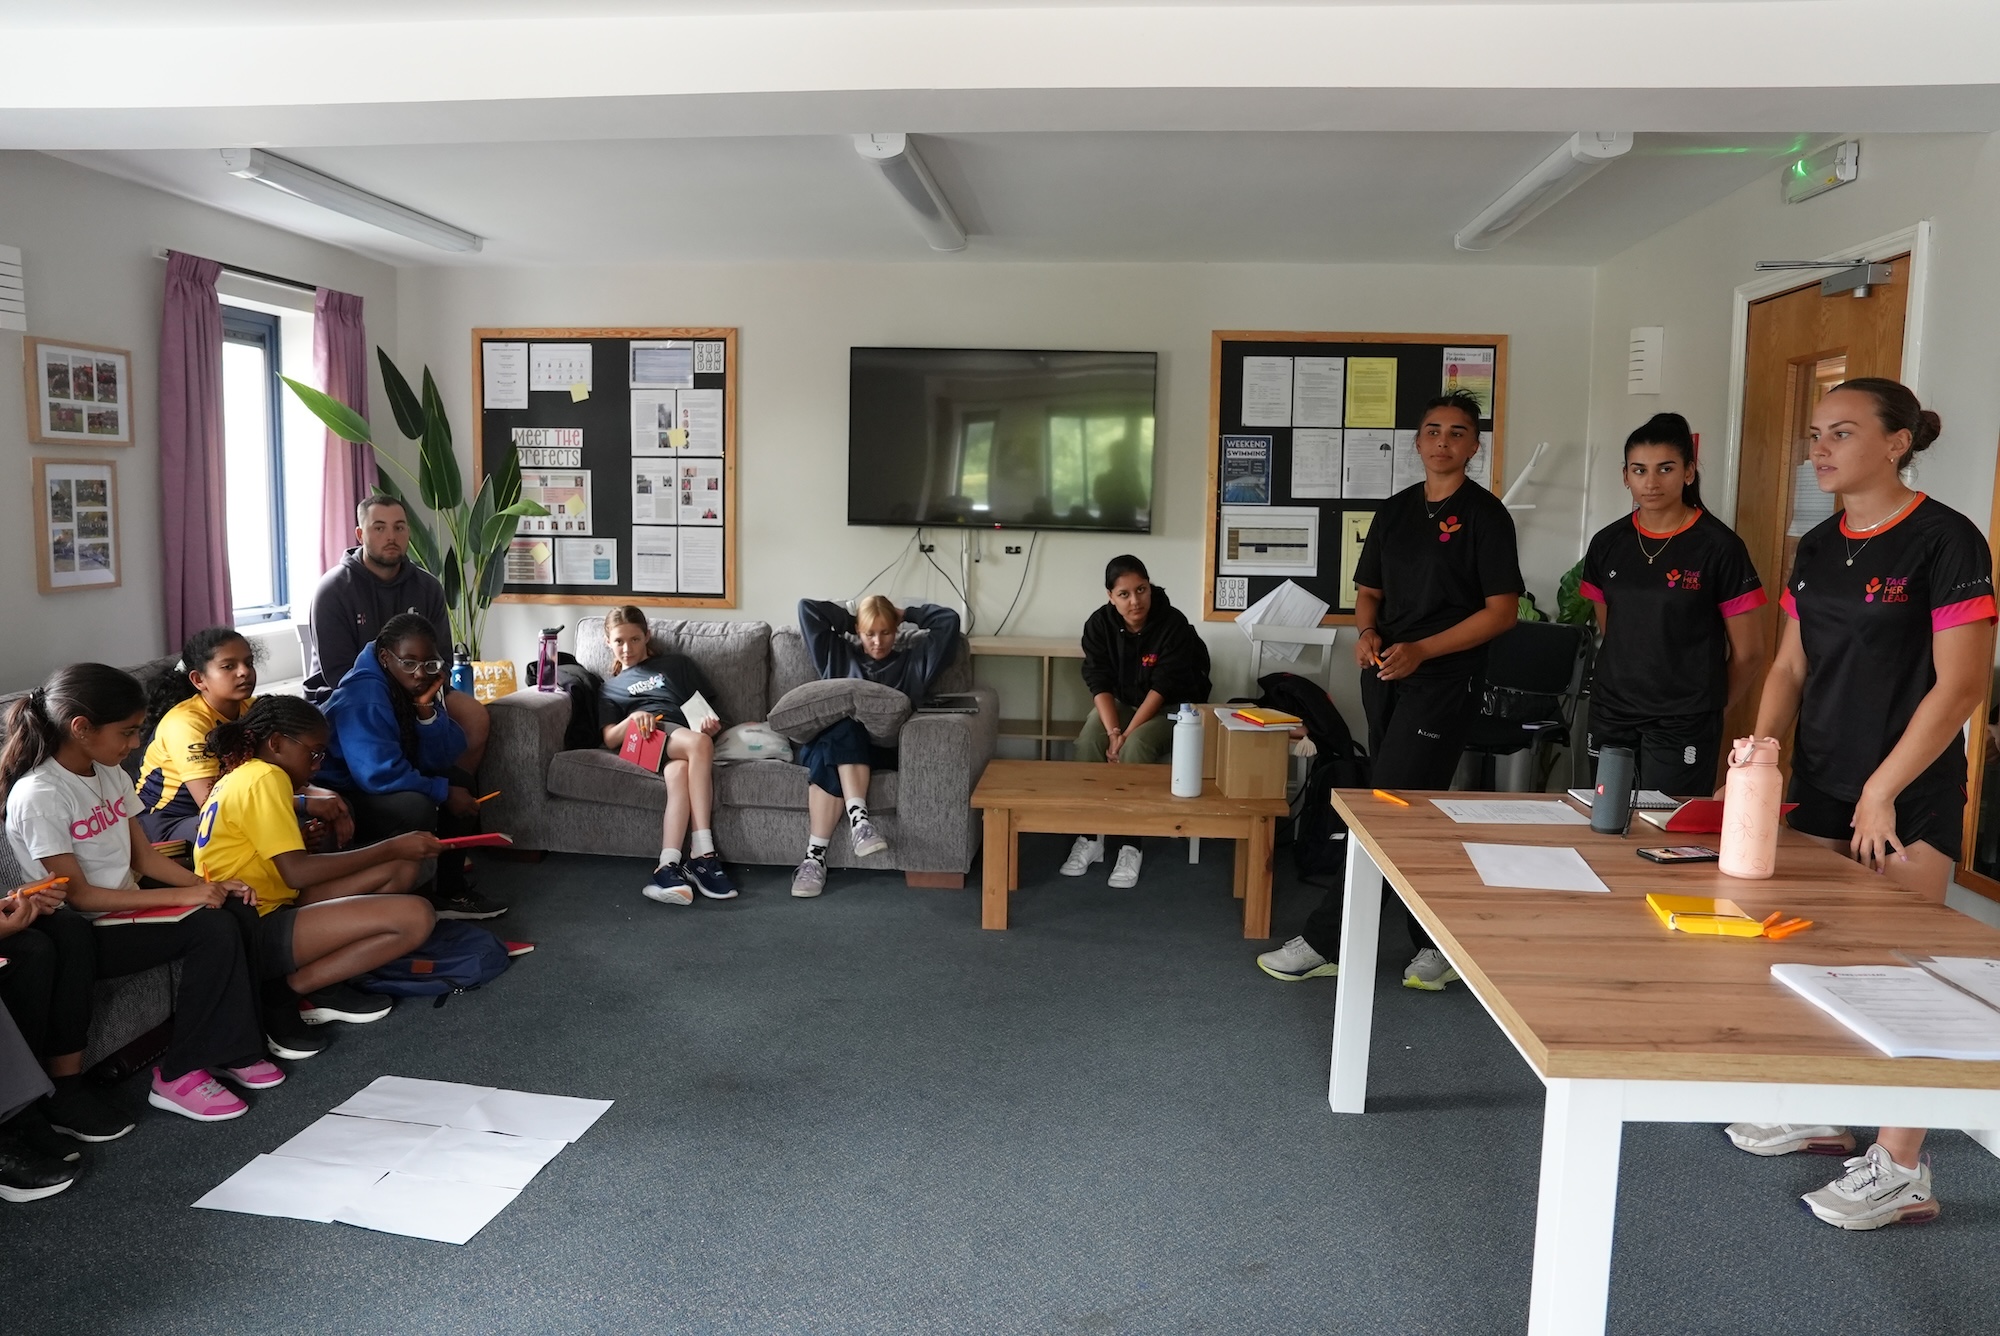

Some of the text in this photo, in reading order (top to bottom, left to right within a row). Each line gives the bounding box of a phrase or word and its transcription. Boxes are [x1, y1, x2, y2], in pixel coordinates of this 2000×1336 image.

[1226, 440, 1267, 448] WEEKEND
[1219, 579, 1245, 589] THE
[1885, 577, 1908, 585] TAKE
[1951, 578, 1982, 591] LACUNA
[1884, 586, 1903, 594] HER
[1882, 594, 1908, 602] LEAD
[474, 665, 513, 680] APPY
